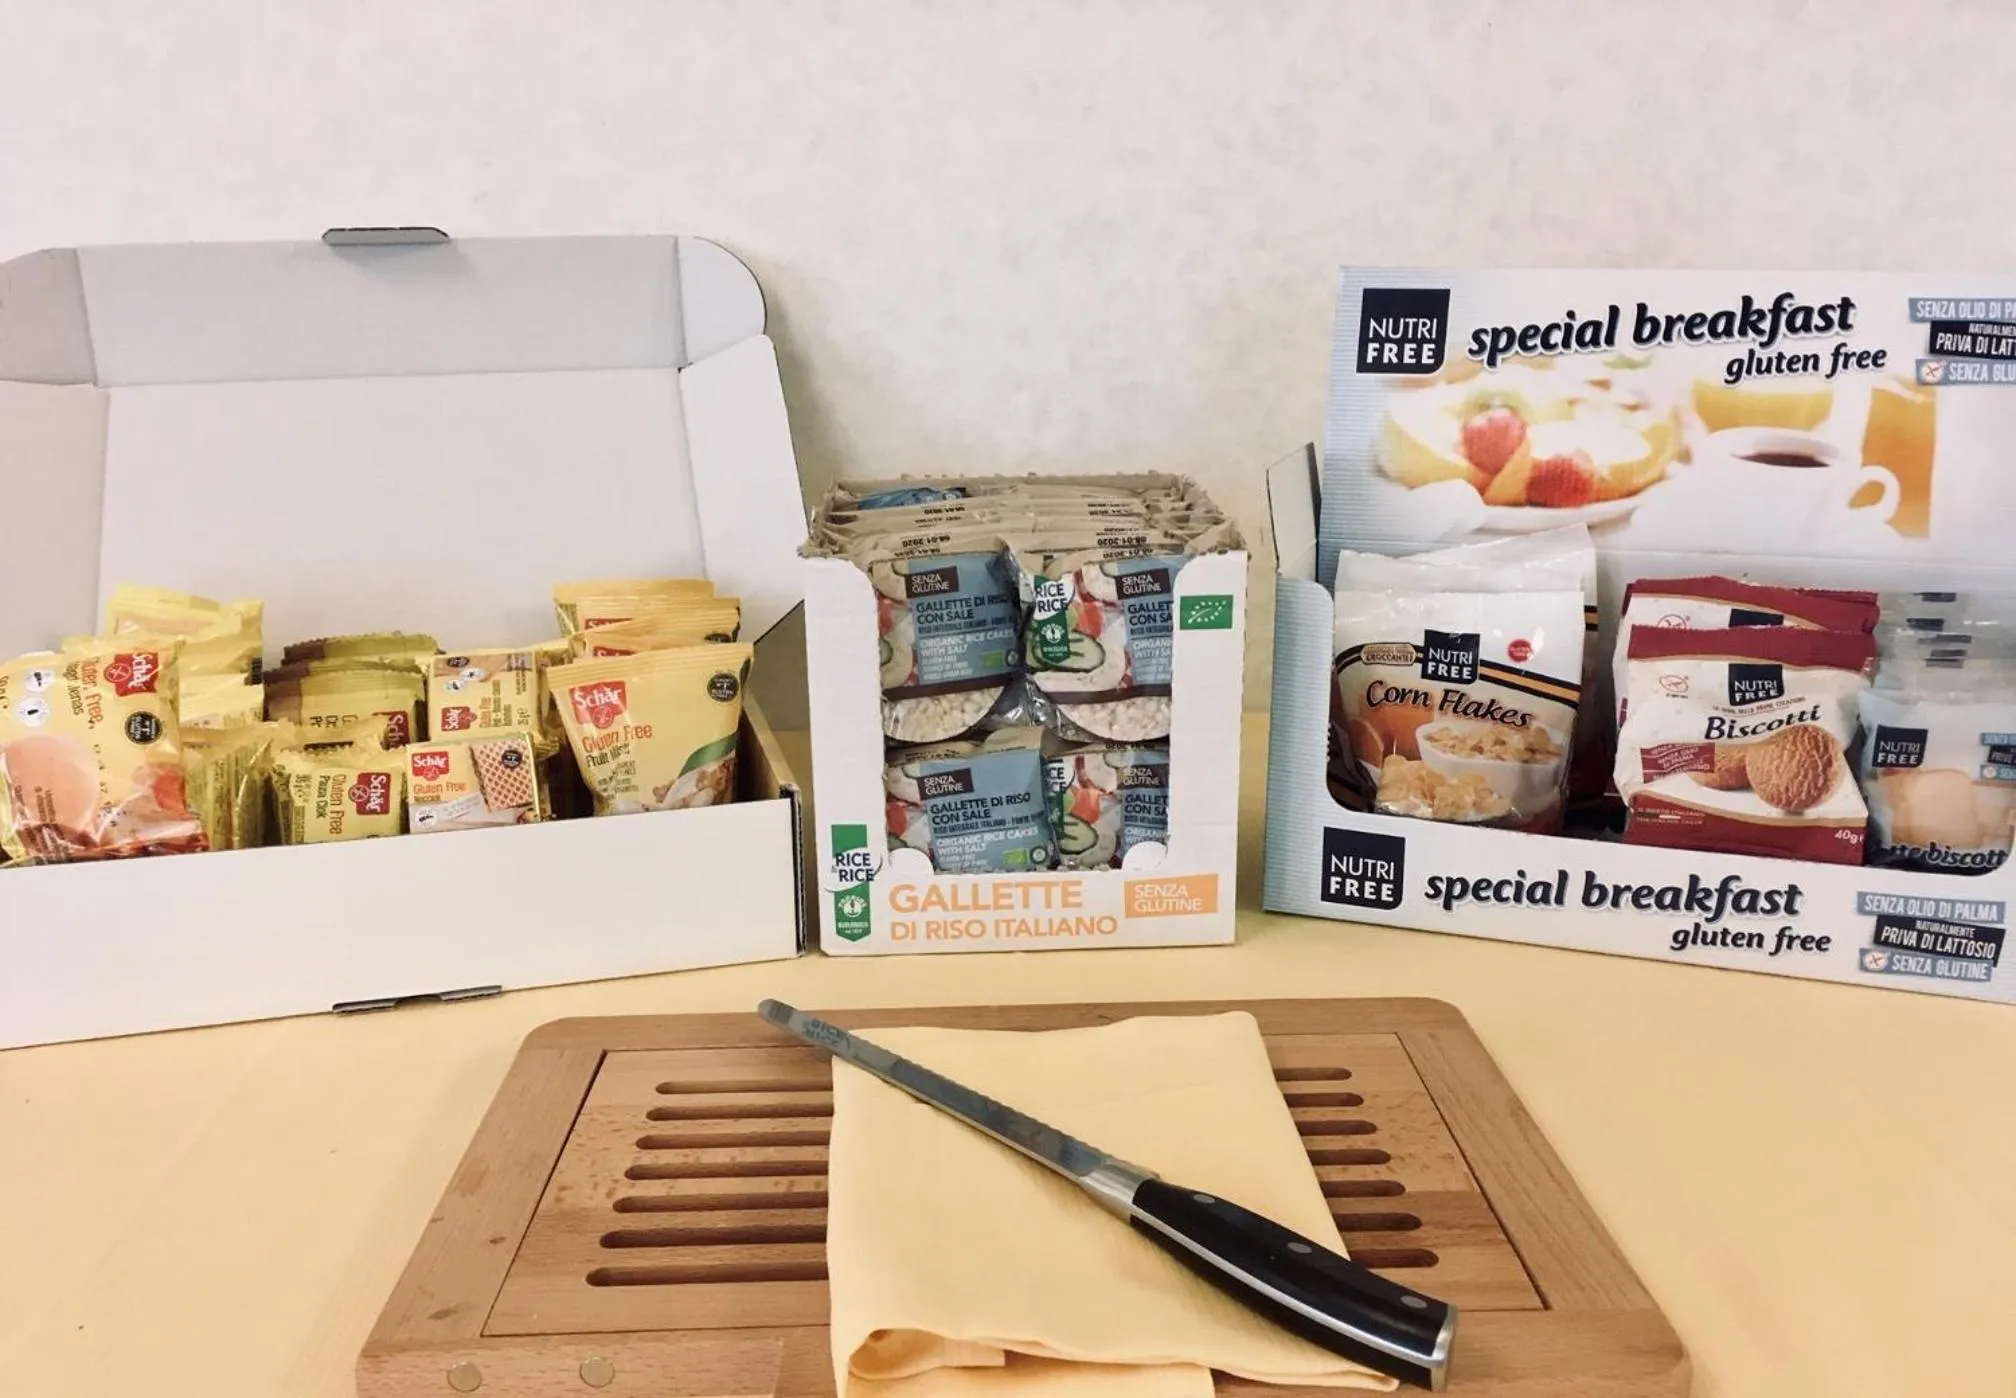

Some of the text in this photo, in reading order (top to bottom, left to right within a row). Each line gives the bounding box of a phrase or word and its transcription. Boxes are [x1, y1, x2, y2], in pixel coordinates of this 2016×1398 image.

[1916, 300, 1956, 318] SENZA
[1958, 301, 1986, 318] OLIO
[1989, 302, 2001, 318] DI
[1369, 317, 1437, 339] NUTRI
[1467, 292, 1856, 368] special breakfast
[1936, 333, 1972, 352] PRIVA
[1975, 336, 1988, 354] DI
[1366, 343, 1435, 364] FREE
[1724, 343, 1887, 384] gluten free
[1949, 363, 1988, 381] SENZA
[911, 573, 942, 584] SENZA
[1121, 574, 1154, 585] SENZA
[1035, 583, 1065, 598] RICE
[1122, 583, 1162, 595] GLUTINE
[916, 597, 973, 614] GALLETTE
[974, 596, 987, 607] DI
[1037, 598, 1069, 613] RICE
[917, 611, 945, 625] CON
[945, 608, 975, 621] SALE
[1128, 614, 1158, 627] CON
[1429, 647, 1473, 666] NUTRI
[1427, 663, 1473, 680] FREE
[1734, 680, 1777, 692] NUTRI
[1366, 680, 1536, 728] Corn Flakes
[1735, 689, 1779, 703] FREE
[1705, 705, 1822, 740] Biscotti
[624, 724, 653, 741] Free
[1880, 740, 1920, 753] NUTRI
[1877, 752, 1919, 765] FREE
[923, 775, 956, 787] SENZA
[925, 782, 963, 796] GLUTINE
[366, 774, 387, 813] Schär
[329, 774, 347, 836] Gluten Free
[931, 792, 1032, 815] GALLETTE DI RISO
[1125, 804, 1152, 814] CON
[932, 808, 992, 826] CON SALE
[936, 834, 982, 848] ORGANIC
[1835, 828, 1859, 844] 40g
[937, 844, 963, 855] WITH
[836, 853, 871, 867] RICE
[1331, 853, 1394, 880] NUTRI
[839, 868, 875, 883] RICE
[889, 879, 1083, 914] GALLETTE
[1134, 883, 1190, 899] SENZA
[1329, 876, 1394, 902] FREE
[1424, 869, 1803, 923] special breakfast
[1134, 898, 1202, 913] GLUTINE
[1865, 894, 1998, 921] SENZA OLIO DI PALMA
[890, 915, 1118, 941] DI RISO ITALIANO
[1915, 919, 1976, 938] NATURALMENTE
[1670, 922, 1832, 956] gluten free
[1881, 926, 1996, 959] PRIVA DI LATTOSIO
[1892, 954, 1988, 979] SENZA GLUTINE
